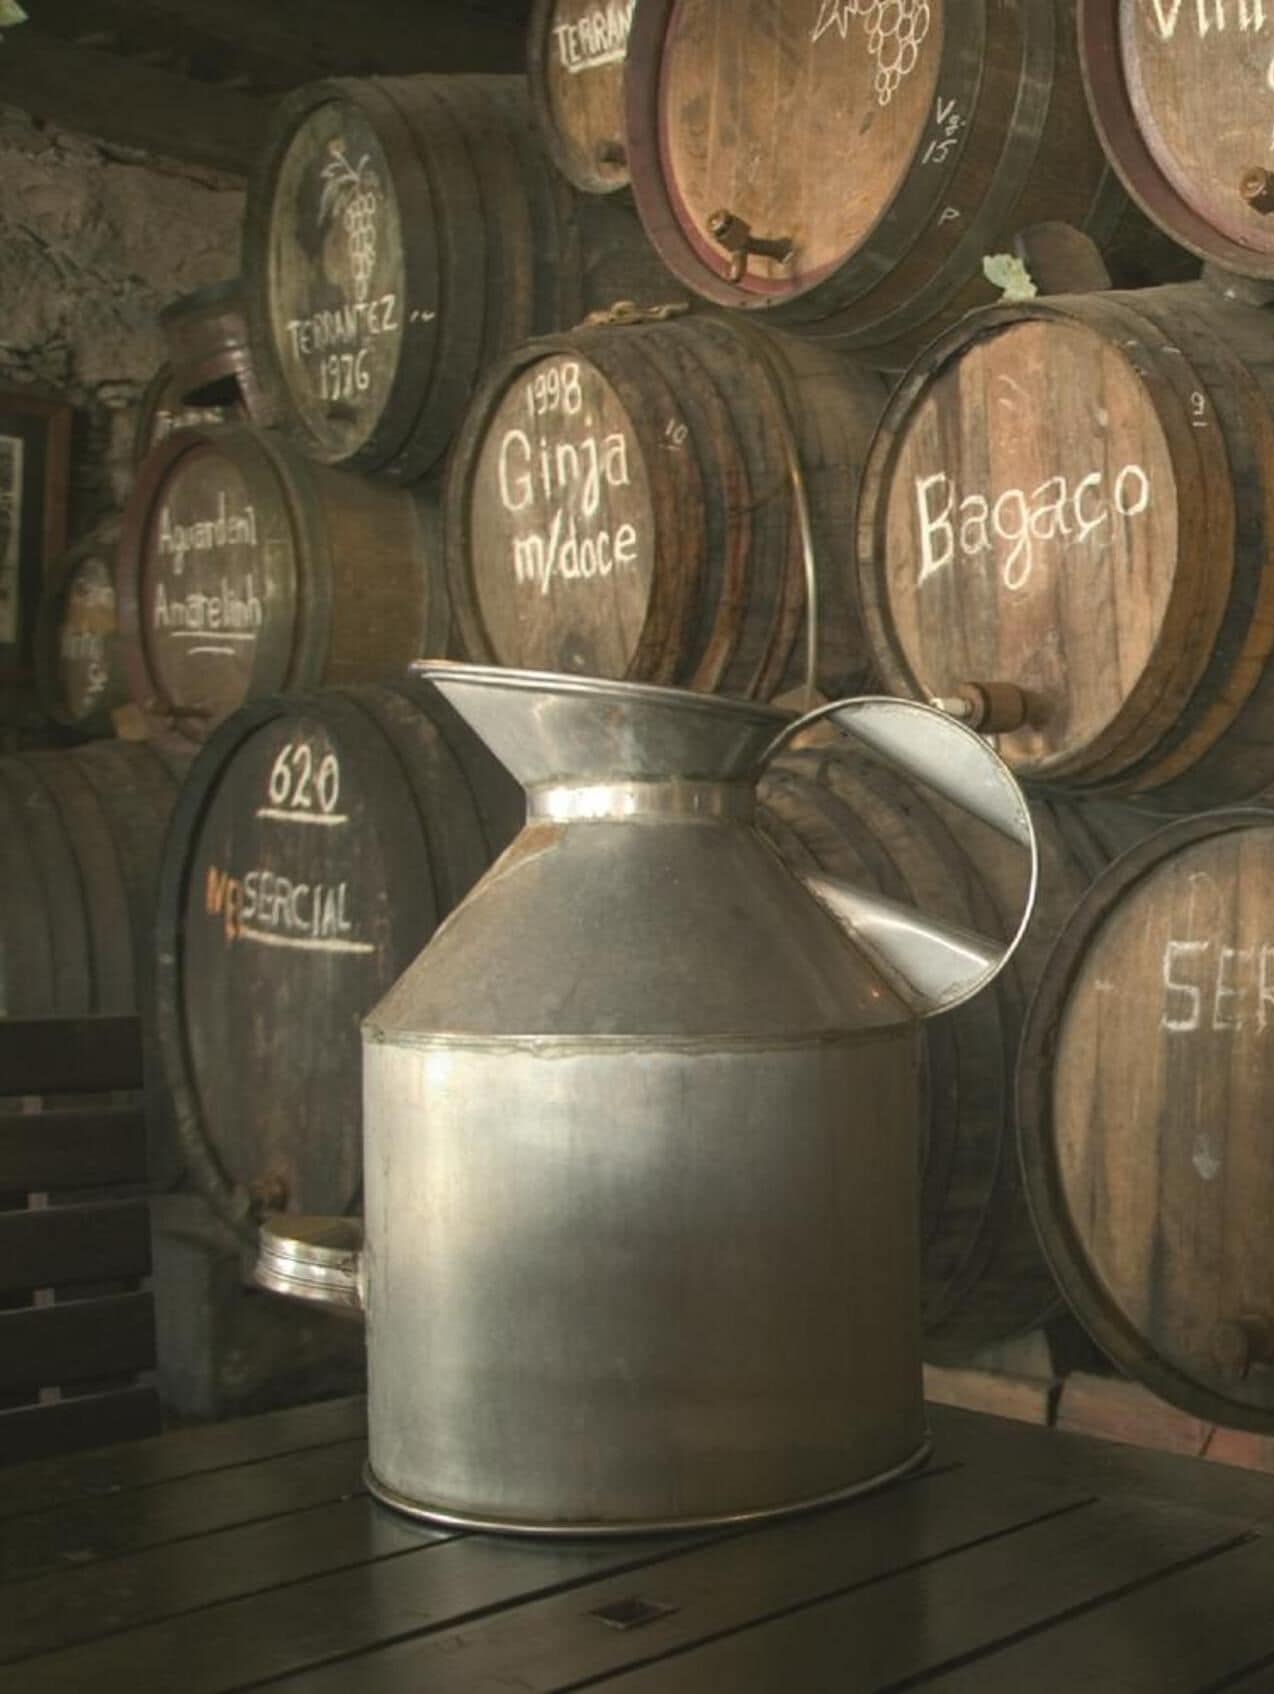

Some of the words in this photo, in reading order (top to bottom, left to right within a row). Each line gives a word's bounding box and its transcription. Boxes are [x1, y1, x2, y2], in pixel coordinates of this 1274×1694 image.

[320, 348, 370, 401] 1976
[527, 362, 582, 418] 1998
[499, 415, 631, 517] Ginja
[268, 743, 340, 813] 620
[243, 870, 352, 937] SERCIAL
